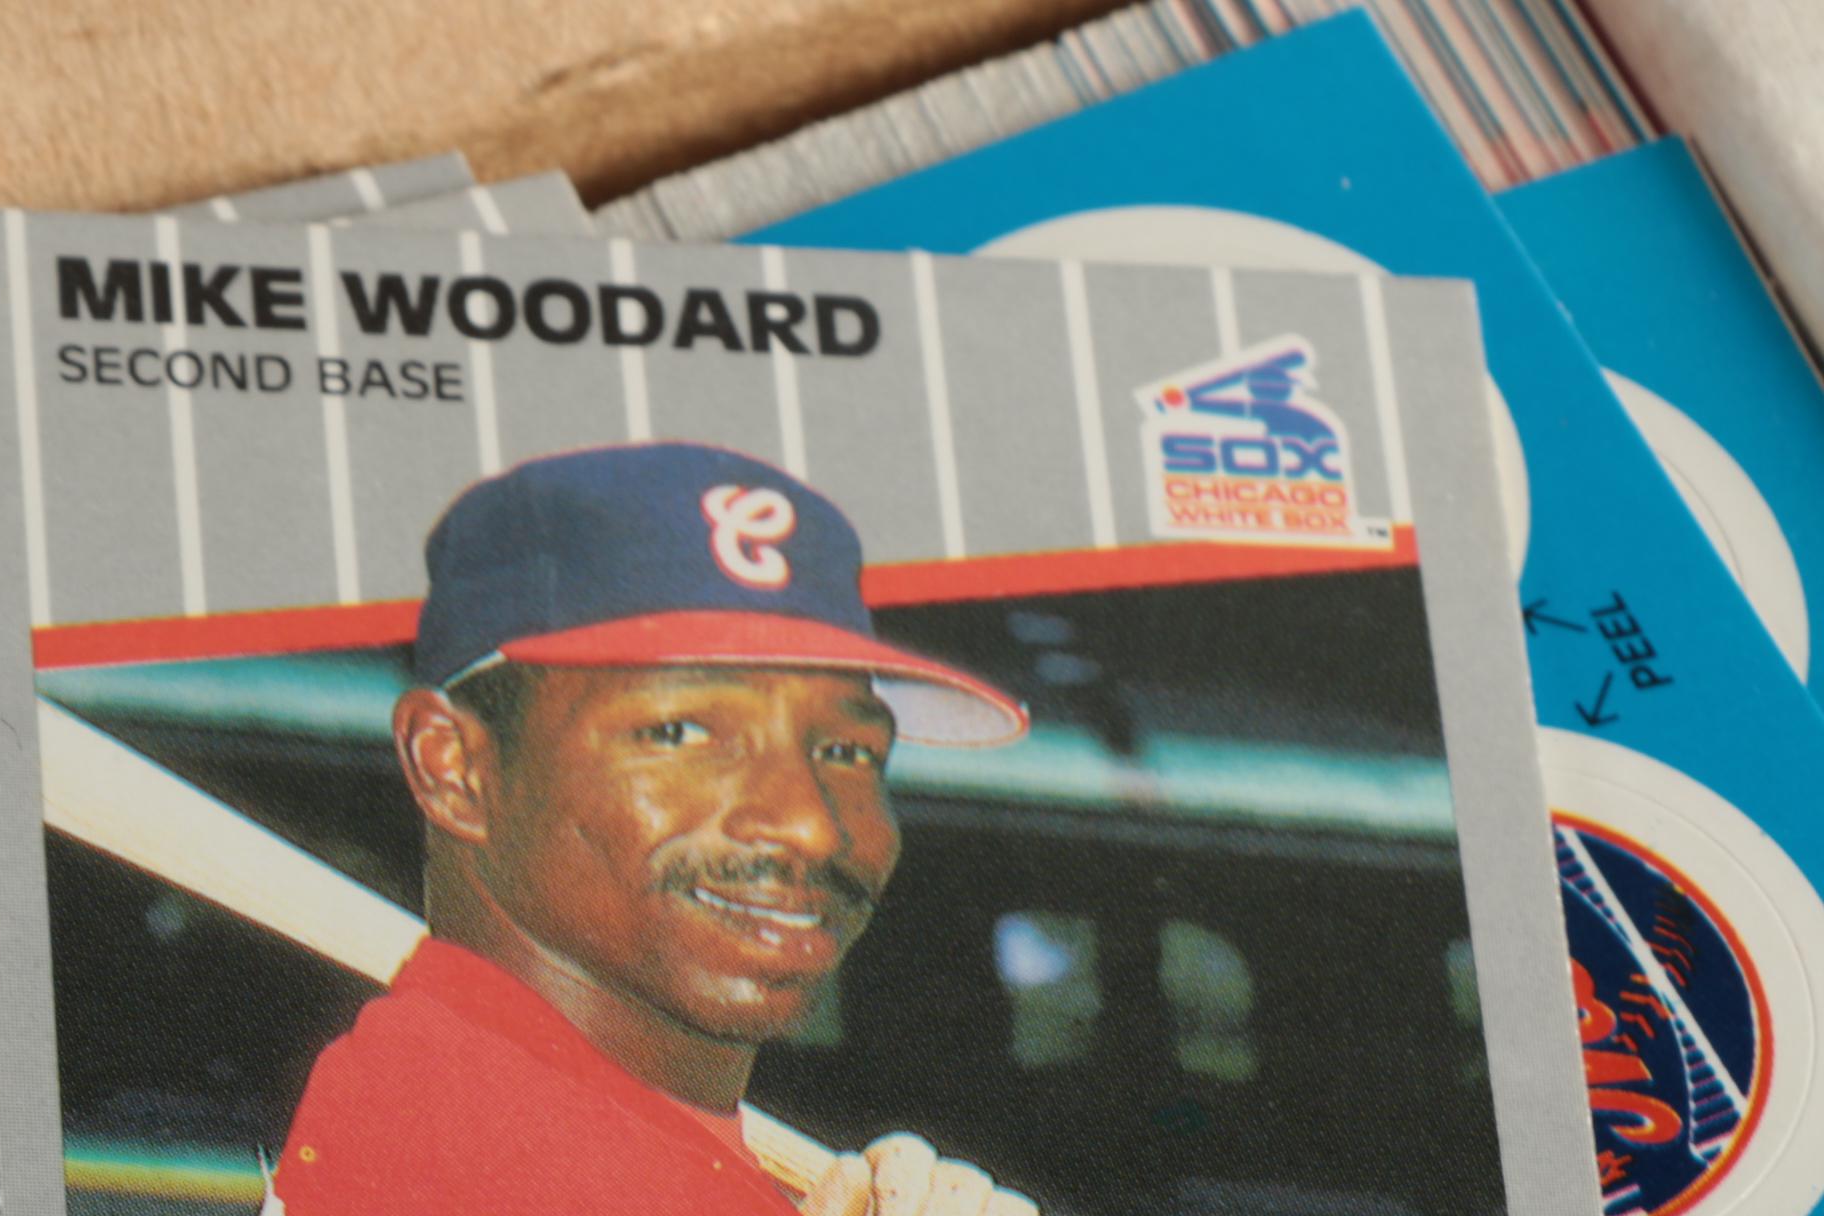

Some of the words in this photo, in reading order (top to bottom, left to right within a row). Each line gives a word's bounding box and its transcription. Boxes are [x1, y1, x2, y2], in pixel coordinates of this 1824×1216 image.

[56, 255, 308, 332] MIKE
[341, 270, 882, 358] WOODARD
[57, 343, 293, 394] SECOND
[317, 357, 466, 402] BASE
[1161, 432, 1343, 481] SOX
[1164, 479, 1349, 508] CHICAGO
[1590, 590, 1676, 692] PEEL
